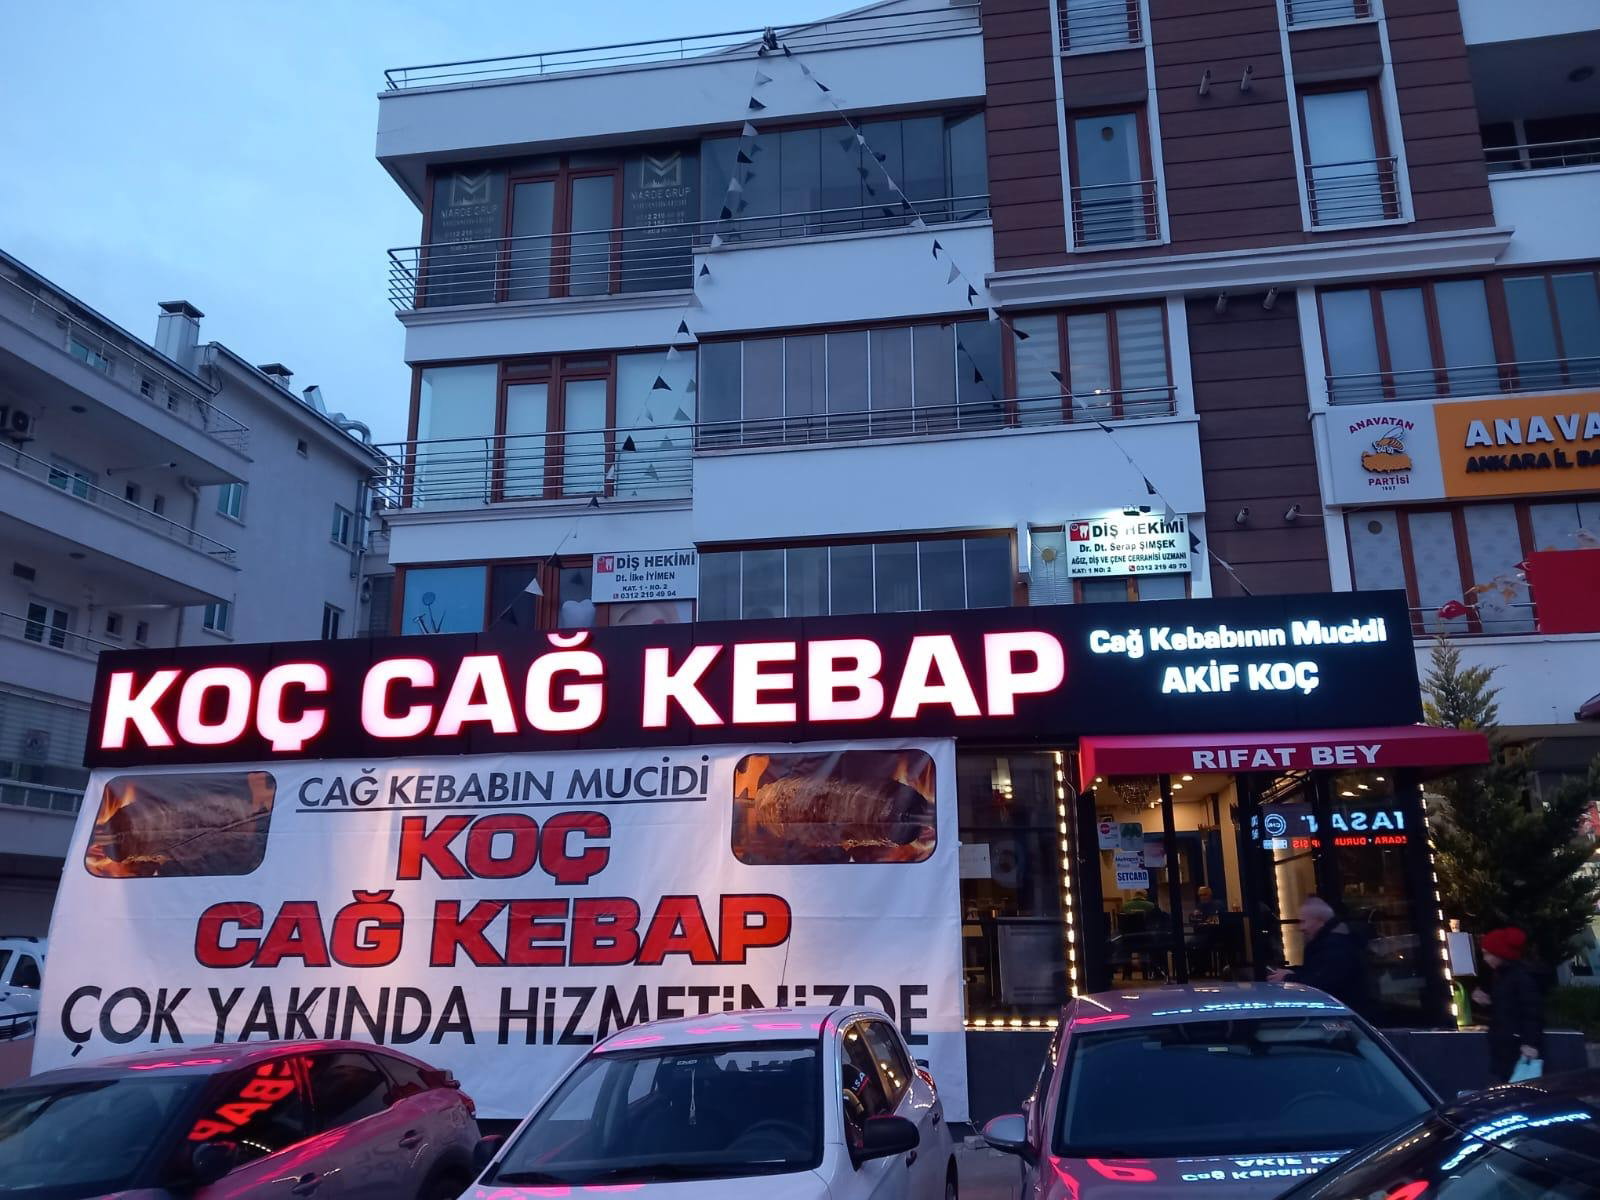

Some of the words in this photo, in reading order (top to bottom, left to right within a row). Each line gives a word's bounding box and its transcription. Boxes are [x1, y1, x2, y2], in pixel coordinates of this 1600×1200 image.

[1349, 416, 1414, 435] ANAVATAN
[1466, 453, 1553, 473] ANKARA
[1368, 474, 1410, 486] PARTİSİ
[1092, 522, 1119, 539] DİŞ
[1079, 544, 1092, 553] Dr.
[1094, 543, 1107, 552] Dt.
[1110, 543, 1136, 552] Serap
[616, 555, 640, 571] DİŞ
[644, 551, 696, 567] HEKİMİ
[1089, 556, 1099, 565] DİŞ
[1110, 555, 1126, 564] ÇENE
[1128, 553, 1161, 562] CERRAHİSİ
[1162, 552, 1187, 560] UZMANI
[616, 574, 628, 582] Dt.
[646, 571, 676, 580] İYİMEN
[1089, 627, 1144, 659] Cağ
[1149, 625, 1286, 651] Kebabının
[1291, 618, 1388, 645] Mucidi
[1161, 659, 1239, 694] AKİF
[1248, 661, 1320, 695] KOÇ
[100, 662, 329, 752] KOÇ
[360, 631, 605, 738] CAĞ
[642, 631, 1066, 728] KEBAP
[1191, 747, 1297, 769] RIFAT
[1310, 744, 1382, 766] BEY
[298, 767, 379, 808] CAĞ
[386, 769, 554, 806] KEBABIN
[567, 754, 709, 800] MUCİDİ
[396, 811, 611, 886] KOÇ
[1117, 871, 1148, 881] SETCARD
[194, 889, 404, 969] CAĞ
[429, 893, 792, 967] KEBAP
[60, 985, 192, 1057] ÇOK
[207, 984, 476, 1045] YAKINDA
